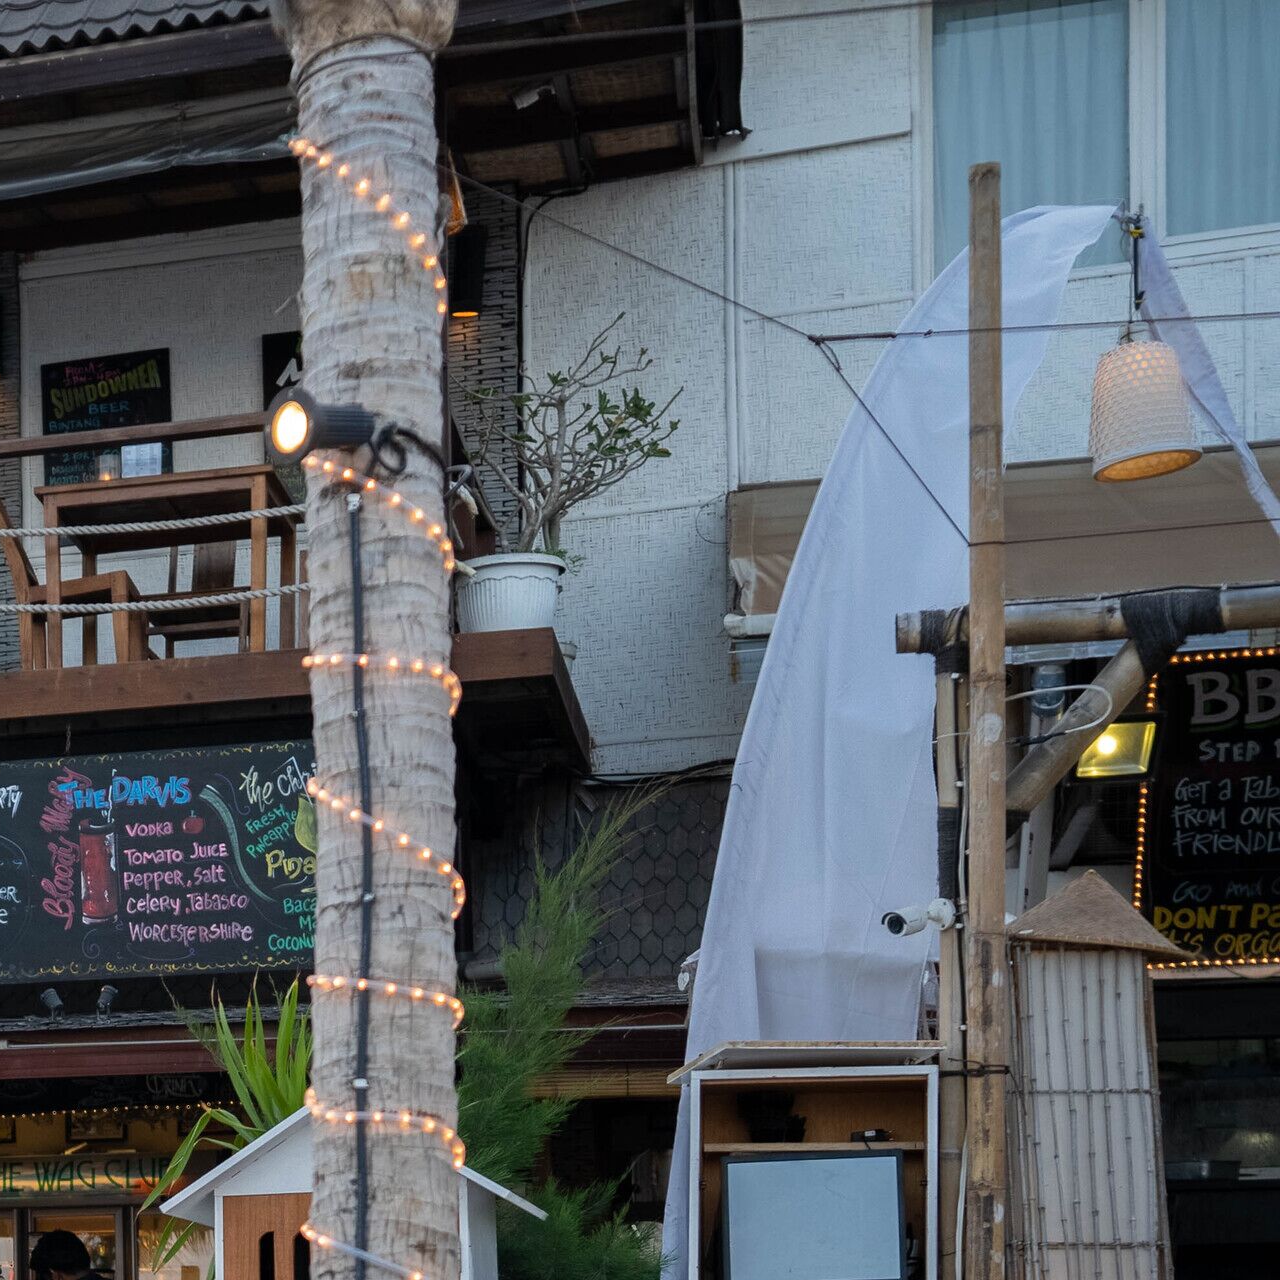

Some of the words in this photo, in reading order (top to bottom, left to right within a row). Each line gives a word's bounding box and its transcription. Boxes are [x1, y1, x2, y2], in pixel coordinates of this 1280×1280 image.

[49, 357, 162, 419] SUNDOWNER
[88, 400, 130, 415] BEER
[48, 418, 100, 433] BINTANG
[1198, 738, 1260, 763] STEP
[56, 778, 111, 811] THE
[111, 775, 192, 808] DARVIS
[1174, 776, 1212, 805] GeT
[1217, 778, 1233, 801] a
[125, 820, 173, 838] VODKA
[245, 803, 292, 835] FRESH
[1171, 803, 1228, 830] FROM
[123, 847, 184, 867] TOMATO
[190, 842, 230, 859] JUICE
[1152, 902, 1244, 932] DON'T
[33, 1159, 96, 1193] WAG
